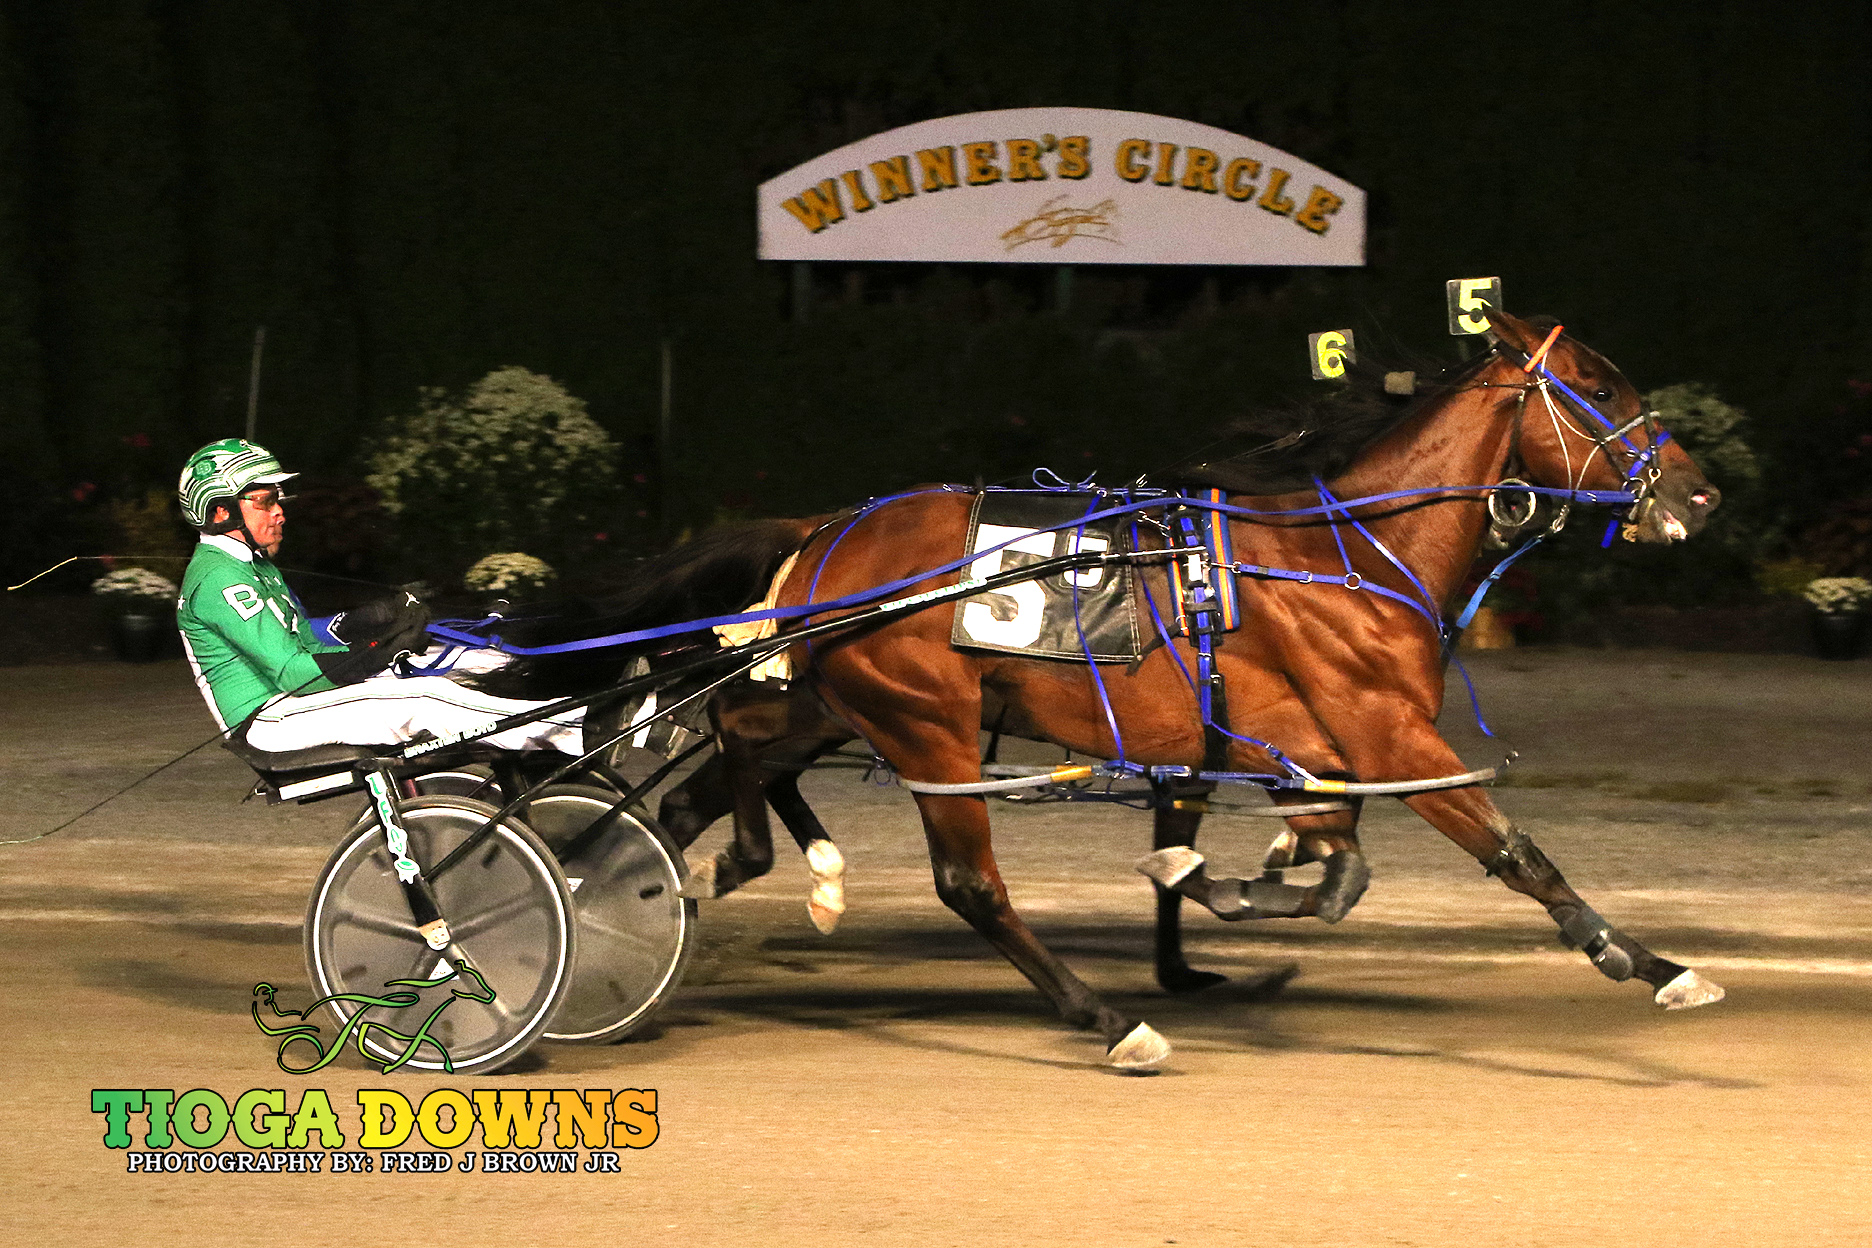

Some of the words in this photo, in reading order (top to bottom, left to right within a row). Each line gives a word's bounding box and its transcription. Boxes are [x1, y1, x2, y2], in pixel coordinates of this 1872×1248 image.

[781, 133, 1093, 234] WINNER'S
[1114, 138, 1344, 236] CIRCLE
[1457, 277, 1493, 334] 5
[1316, 330, 1348, 378] 6
[962, 523, 1057, 649] 5
